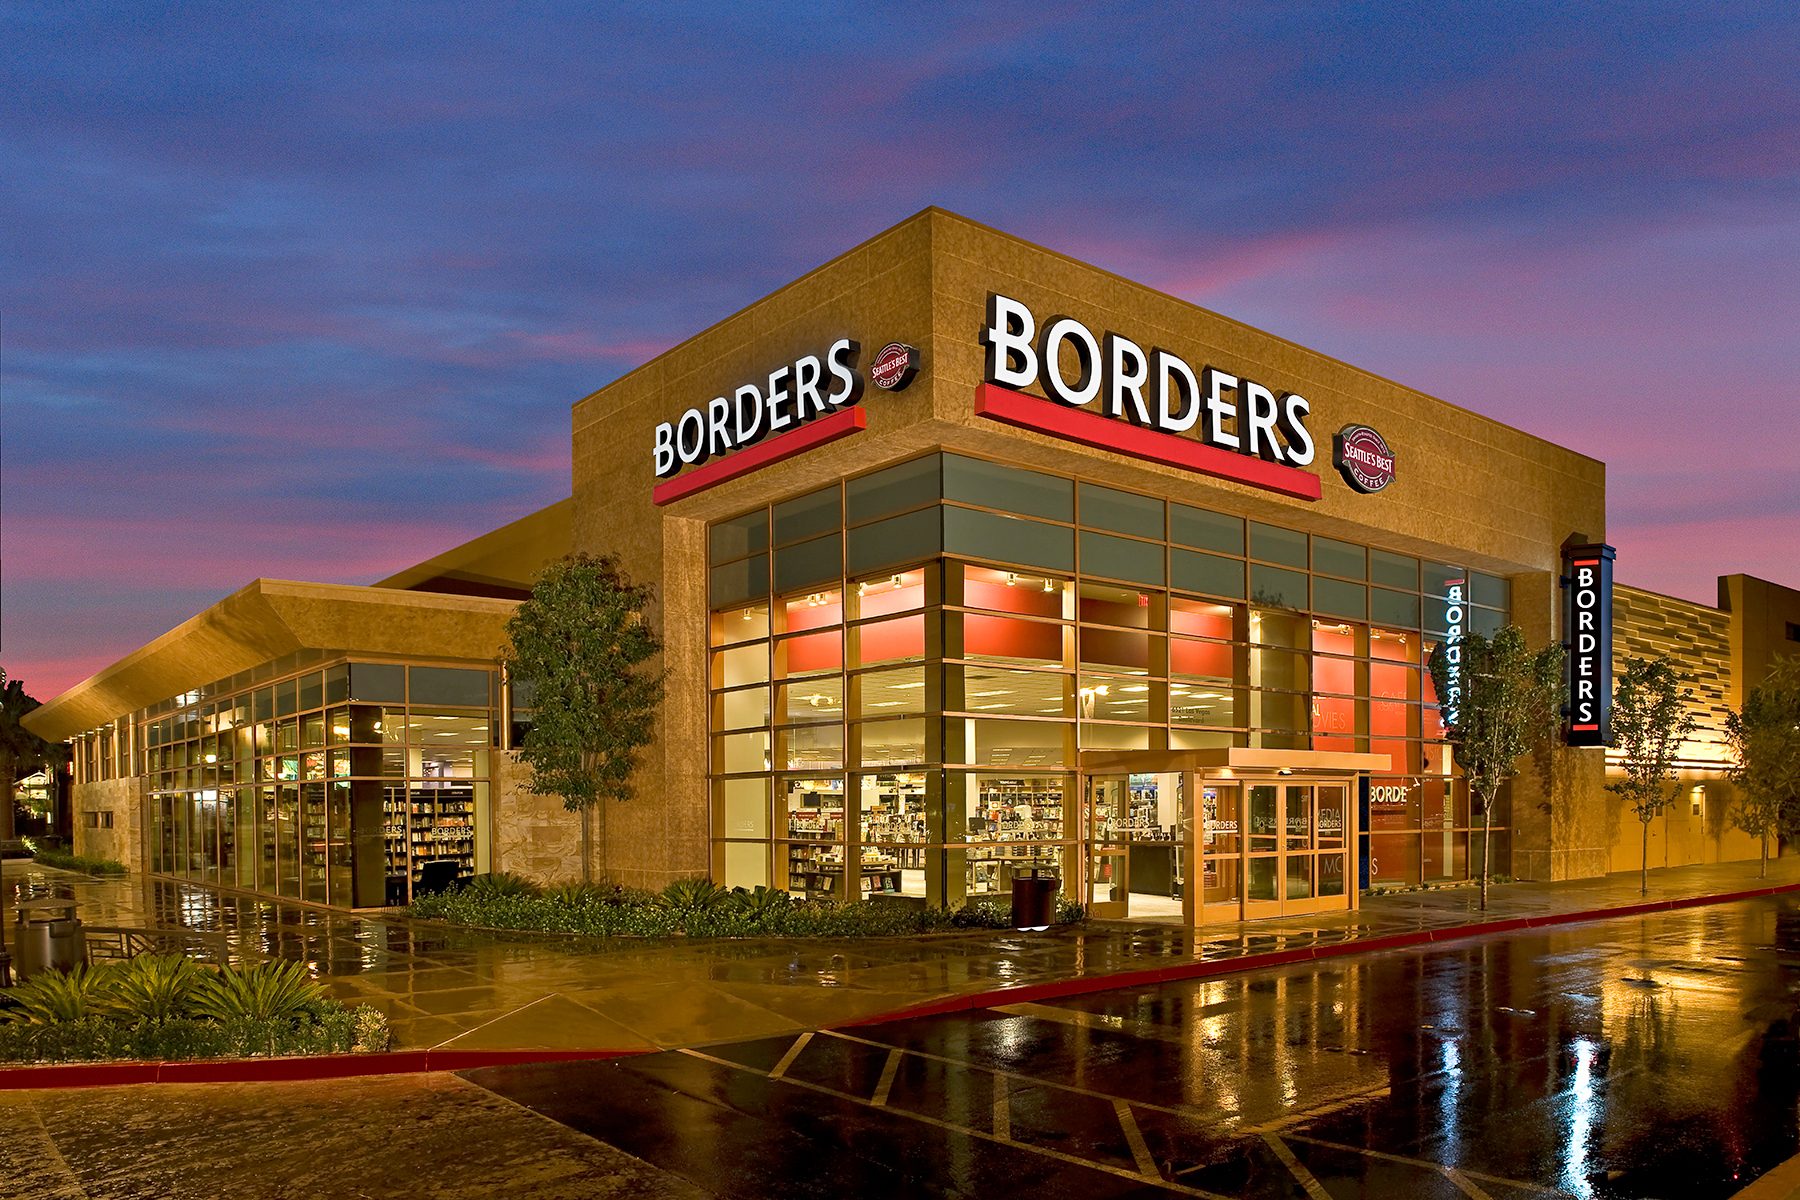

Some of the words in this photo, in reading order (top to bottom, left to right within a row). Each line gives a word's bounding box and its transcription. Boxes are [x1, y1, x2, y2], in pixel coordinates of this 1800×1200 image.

[872, 359, 896, 379] SEATTLE'S
[896, 352, 909, 367] BEST
[988, 293, 1316, 467] BORDERS
[653, 338, 854, 477] BORDERS
[1345, 442, 1376, 467] SEATTLE'S
[1376, 455, 1393, 473] BEST
[1354, 468, 1385, 487] COFFEE
[1577, 568, 1596, 722] BORDERS
[431, 826, 472, 836] BORDERS
[1317, 819, 1342, 829] ORDERS
